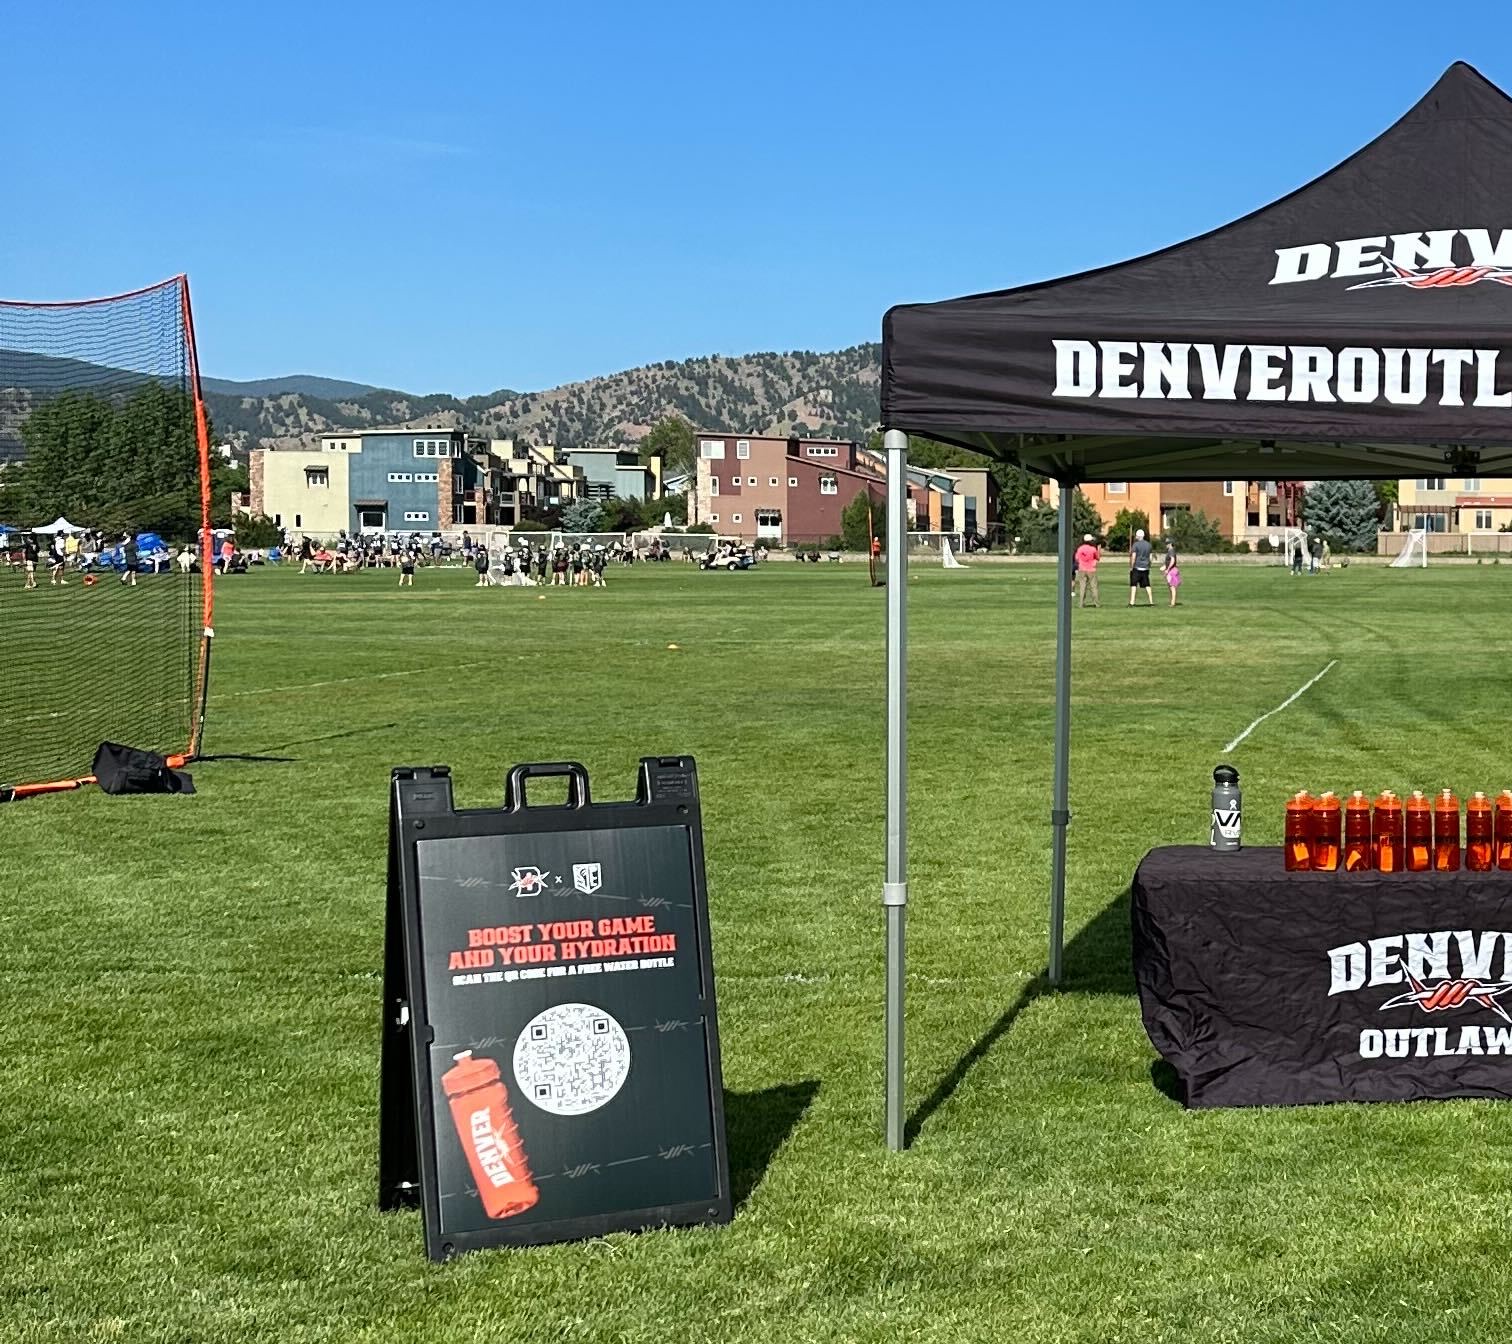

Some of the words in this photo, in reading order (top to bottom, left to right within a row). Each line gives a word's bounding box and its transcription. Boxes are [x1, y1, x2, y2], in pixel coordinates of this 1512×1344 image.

[468, 925, 533, 947] BOOST
[537, 920, 593, 942] YOUR
[598, 915, 655, 936] GAME
[448, 949, 495, 971] AND
[498, 944, 557, 965] YOUR
[560, 934, 677, 960] HYDRATION
[483, 971, 503, 983] THE
[504, 970, 519, 983] QR
[567, 965, 577, 975] A
[603, 959, 639, 972] WATER
[639, 957, 675, 970] BOTTLE
[471, 1105, 516, 1188] DENVER
